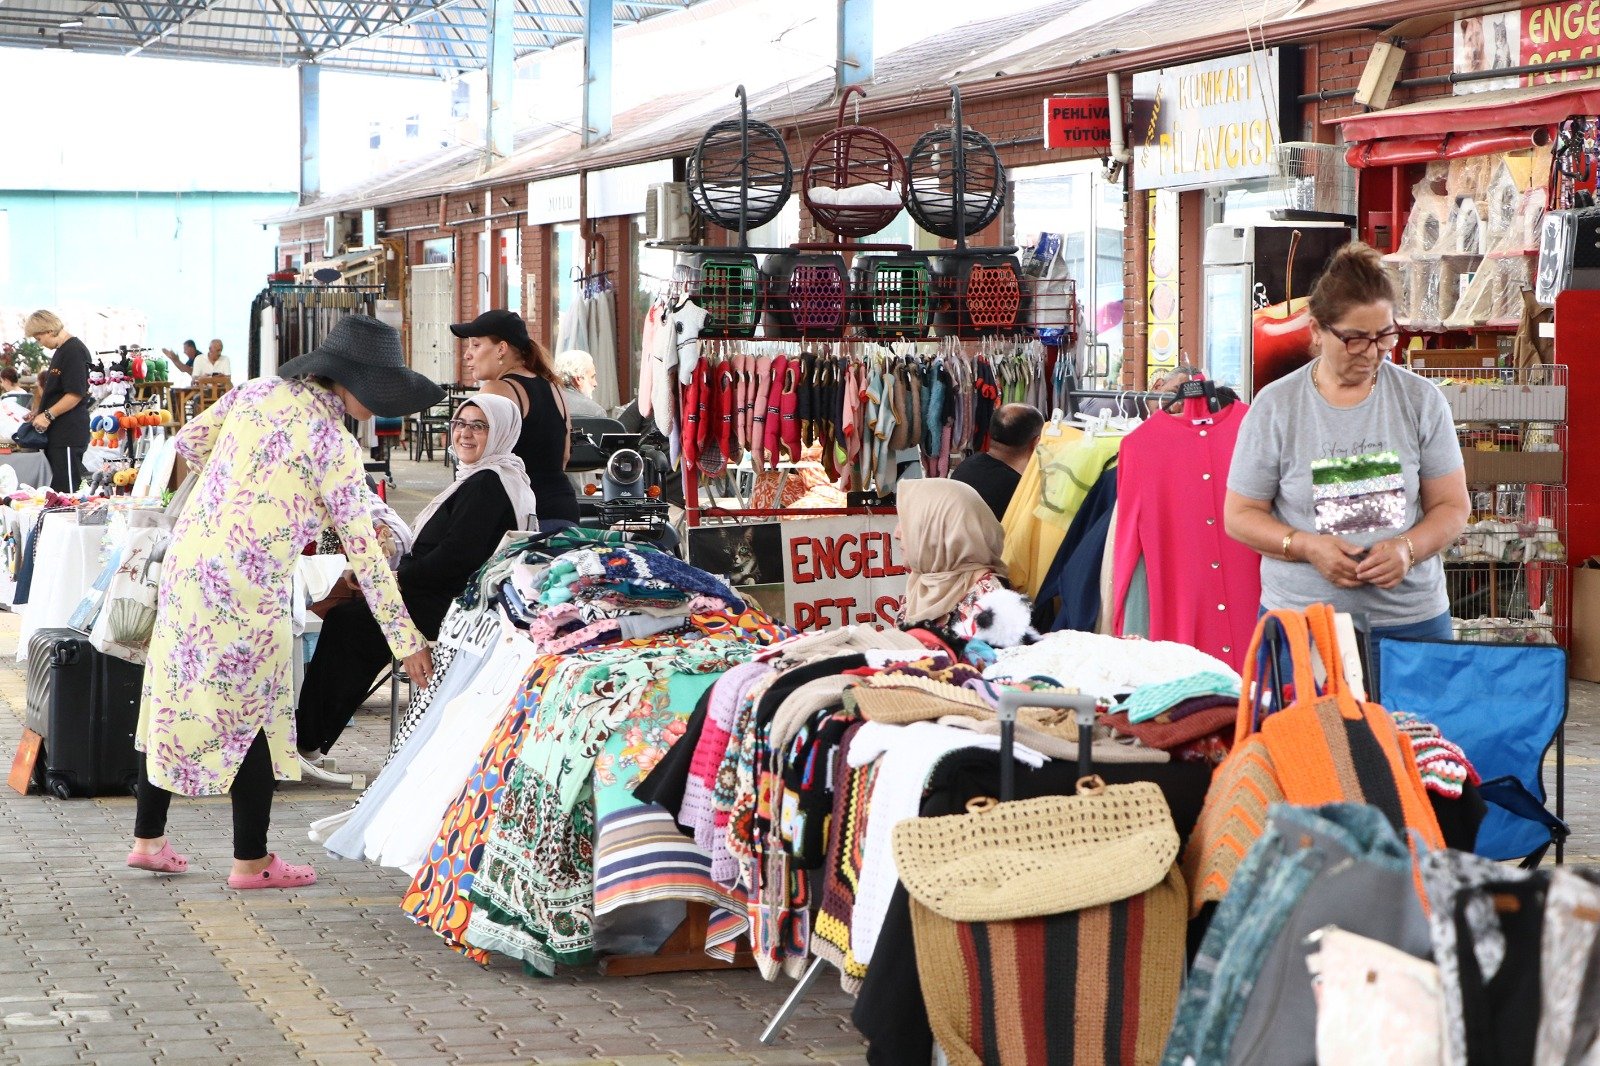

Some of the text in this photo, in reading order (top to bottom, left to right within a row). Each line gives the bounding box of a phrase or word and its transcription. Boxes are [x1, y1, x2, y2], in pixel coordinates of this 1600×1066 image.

[1580, 46, 1600, 79] S
[1179, 65, 1251, 110] KUMKAPI
[1053, 104, 1109, 119] PEHLİVA
[790, 532, 908, 584] ENGEL
